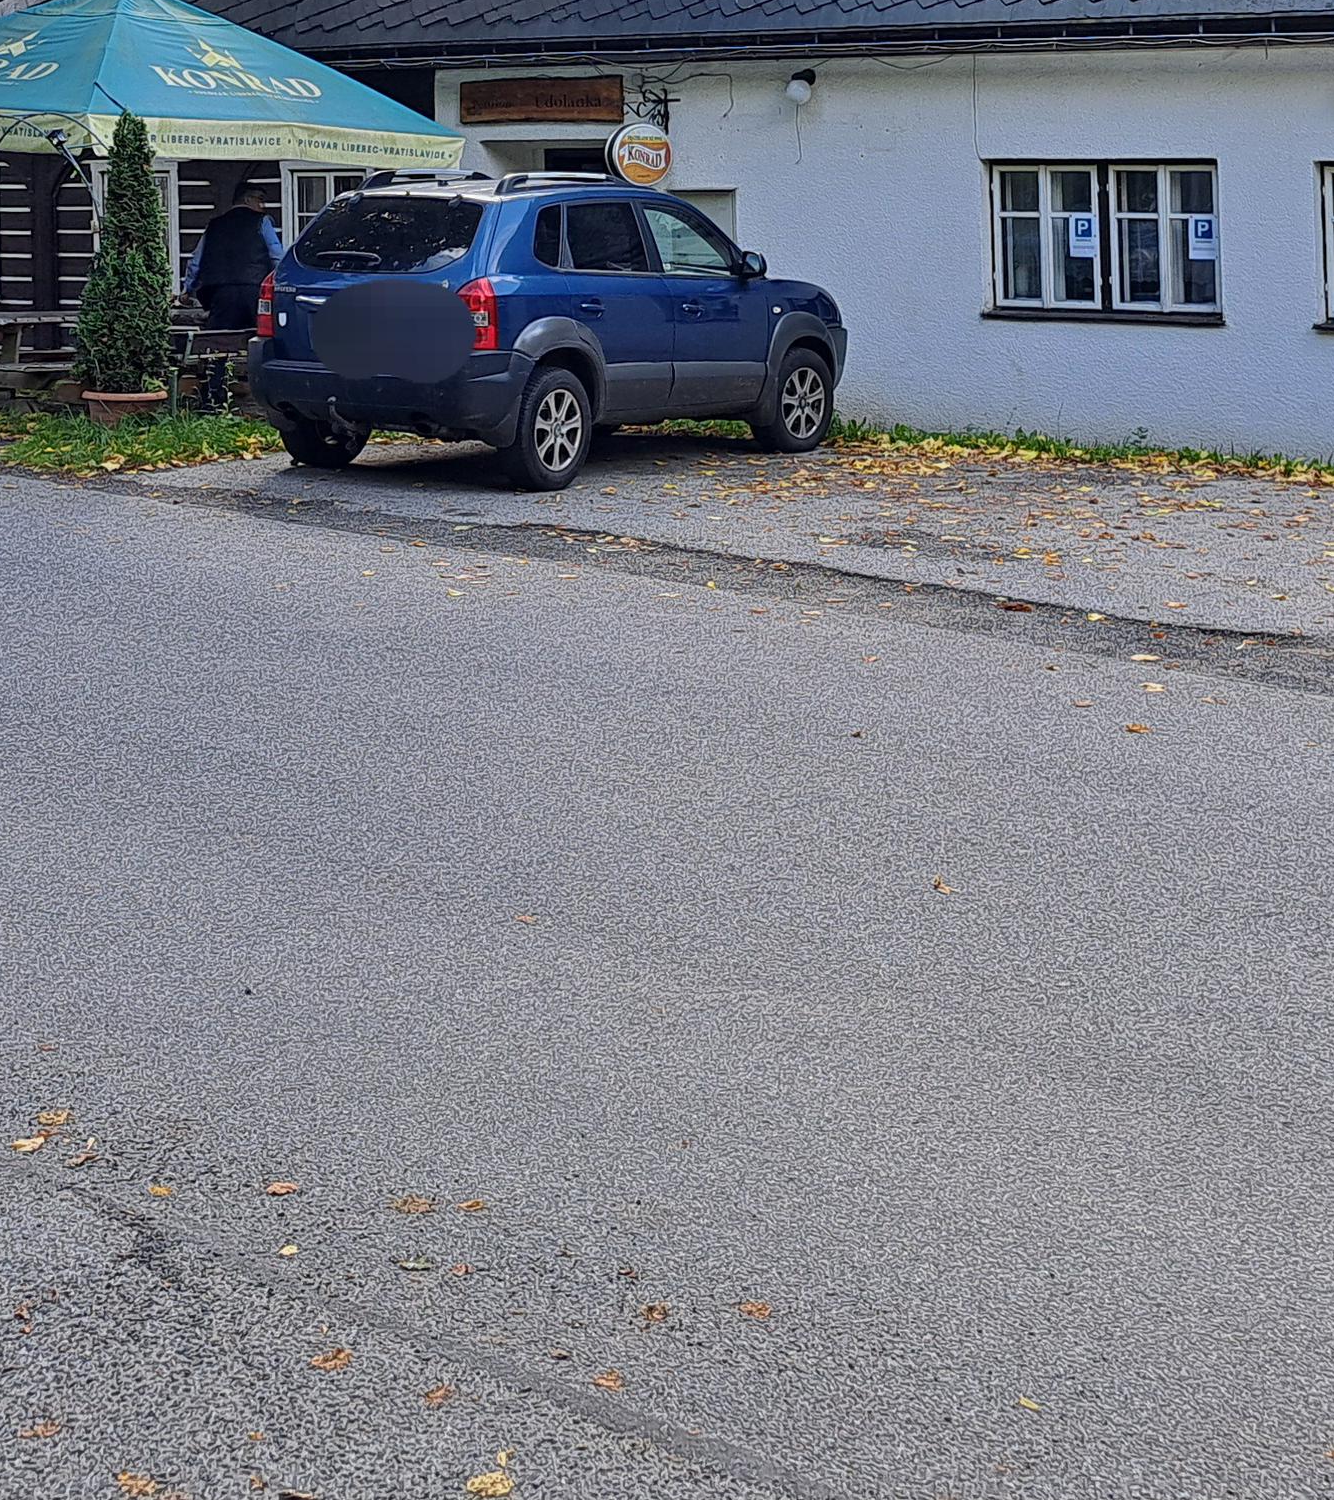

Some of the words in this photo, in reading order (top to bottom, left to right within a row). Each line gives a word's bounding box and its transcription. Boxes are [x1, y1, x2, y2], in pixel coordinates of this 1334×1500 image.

[148, 65, 322, 98] KONRAD
[298, 138, 338, 150] PIVOVAR
[628, 144, 662, 168] KONRAD
[1077, 220, 1089, 235] P
[1197, 221, 1210, 237] P
